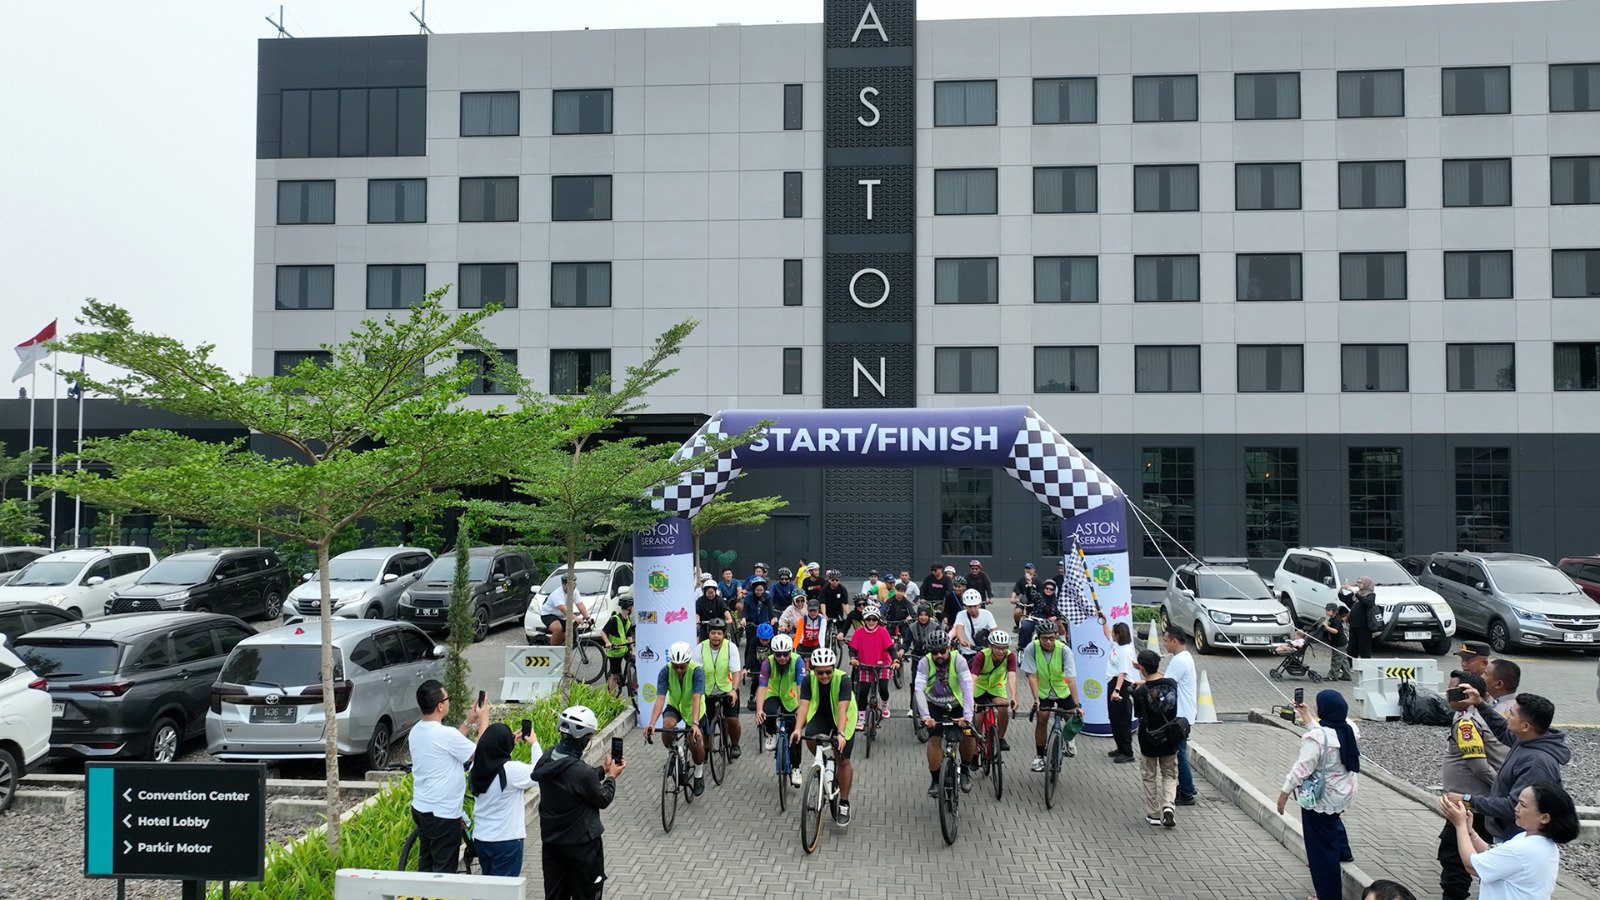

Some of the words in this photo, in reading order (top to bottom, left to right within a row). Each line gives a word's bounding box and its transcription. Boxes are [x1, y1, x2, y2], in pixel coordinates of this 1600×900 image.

[850, 2, 890, 398] ASTON
[749, 424, 999, 455] START/FINISH
[1075, 521, 1120, 535] ASTON
[641, 537, 675, 546] SERANG
[1079, 535, 1117, 545] SERANG
[252, 707, 258, 717] A
[137, 790, 207, 801] Convention
[209, 791, 250, 801] Center
[137, 816, 170, 827] Hotel
[172, 816, 211, 829] Lobby
[137, 842, 174, 853] Parkir
[176, 843, 213, 853] Motor
